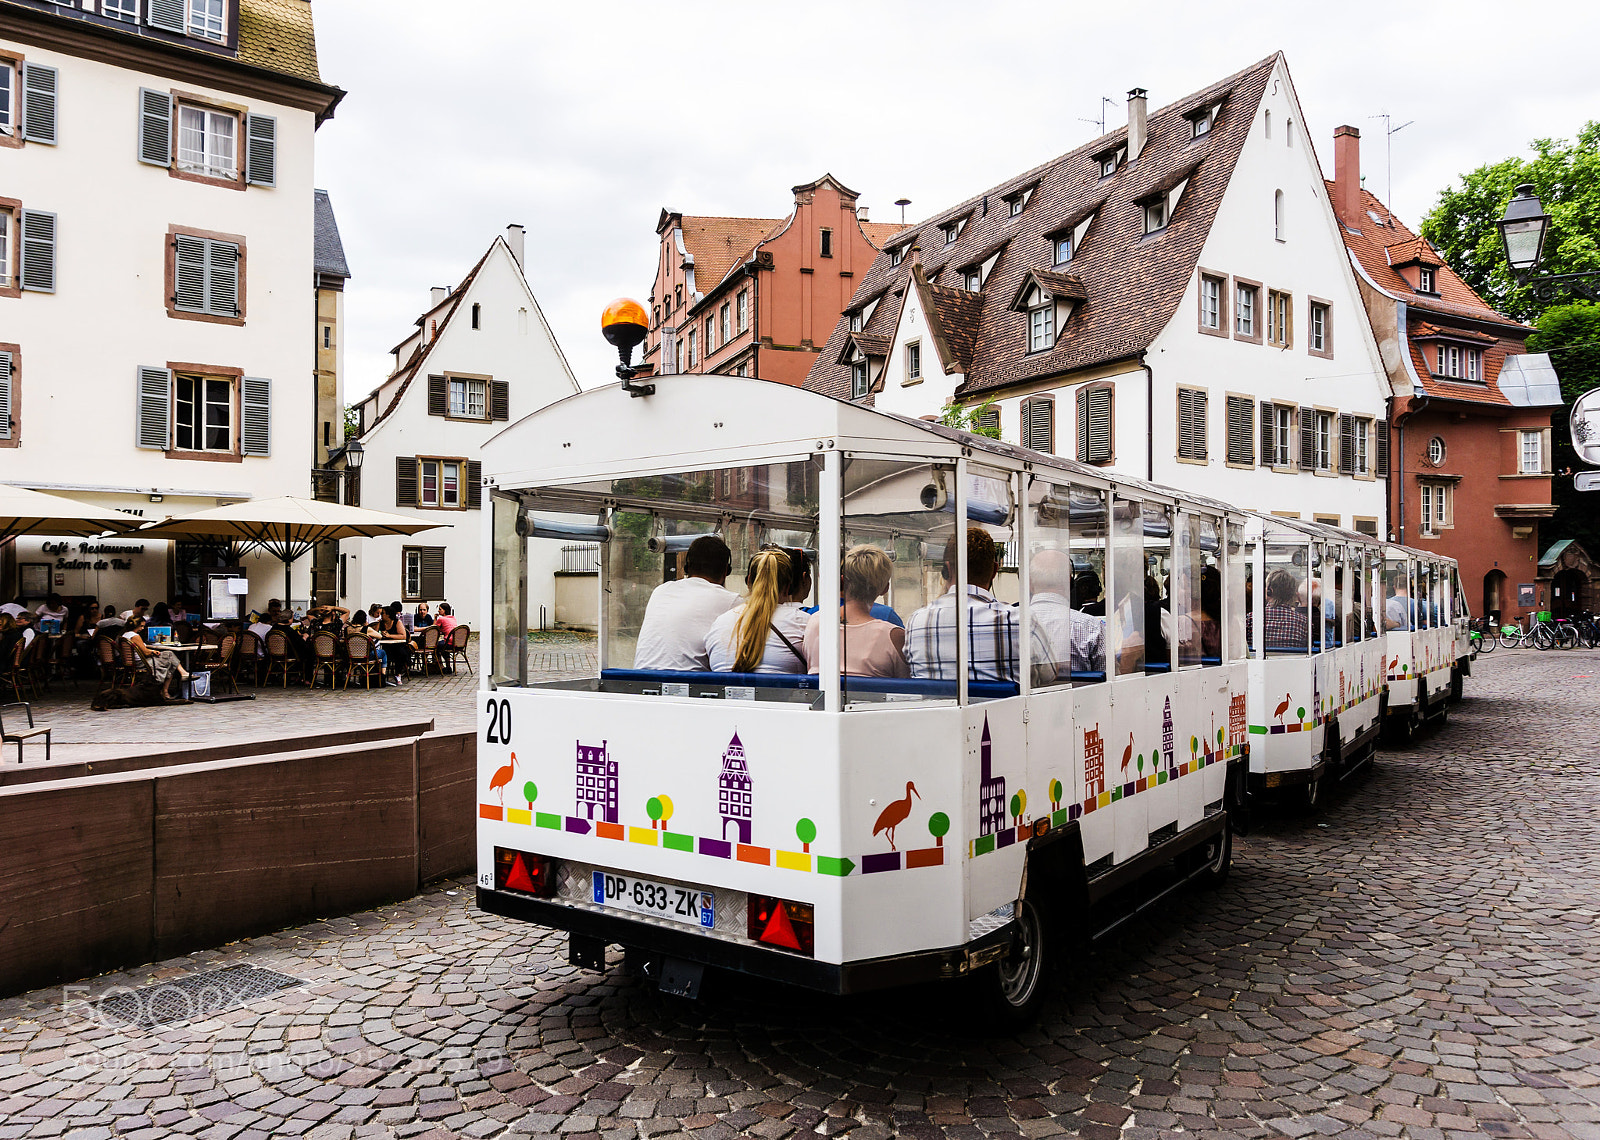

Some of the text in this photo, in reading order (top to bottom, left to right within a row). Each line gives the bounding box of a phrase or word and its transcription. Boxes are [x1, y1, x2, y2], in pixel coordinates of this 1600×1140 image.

[42, 541, 69, 556] Café
[78, 541, 144, 554] Restaurant
[55, 557, 132, 570] Salon de Thé
[486, 698, 511, 745] 20
[605, 875, 699, 918] DP-633-ZK
[702, 911, 712, 925] 67
